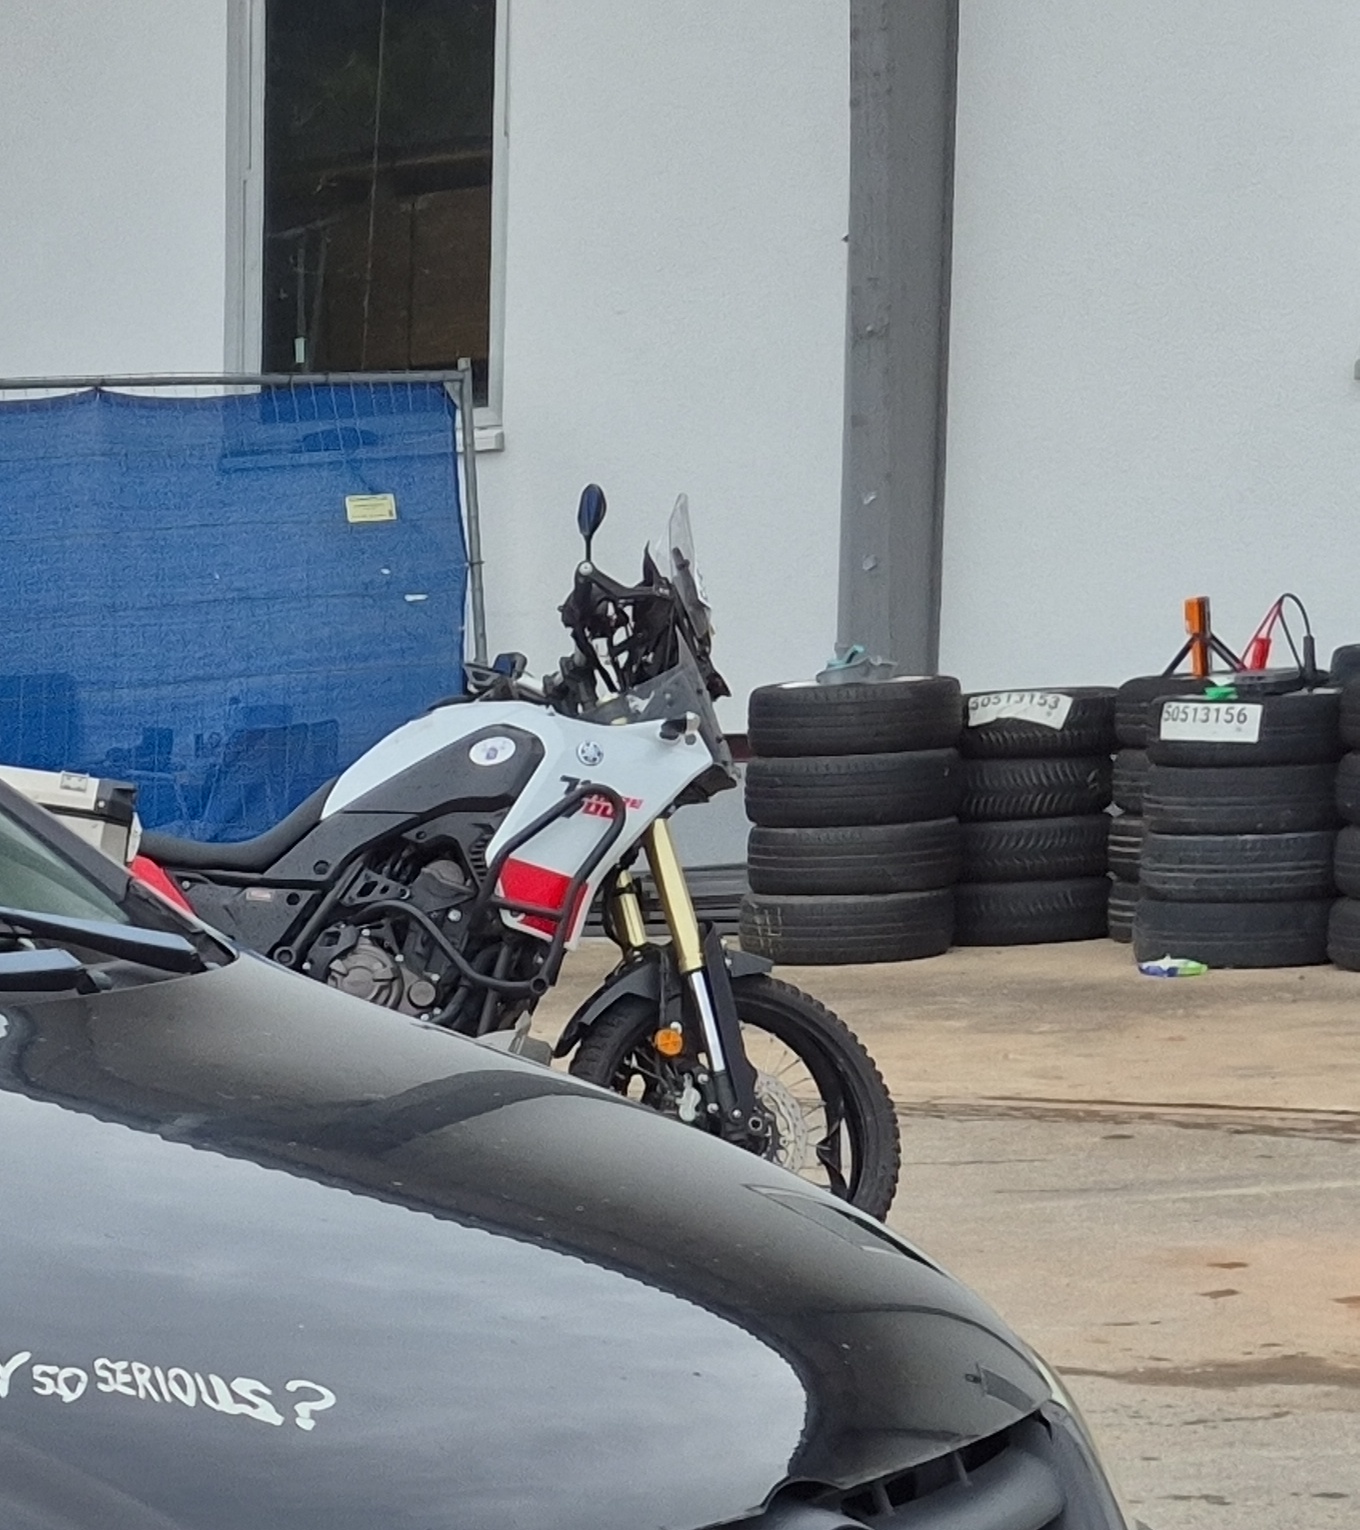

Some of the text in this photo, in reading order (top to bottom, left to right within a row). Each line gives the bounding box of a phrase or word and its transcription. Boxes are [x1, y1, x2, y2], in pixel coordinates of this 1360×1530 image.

[1163, 704, 1248, 725] 50513156
[31, 1364, 88, 1403] SO
[93, 1357, 337, 1431] SERIOUS?
